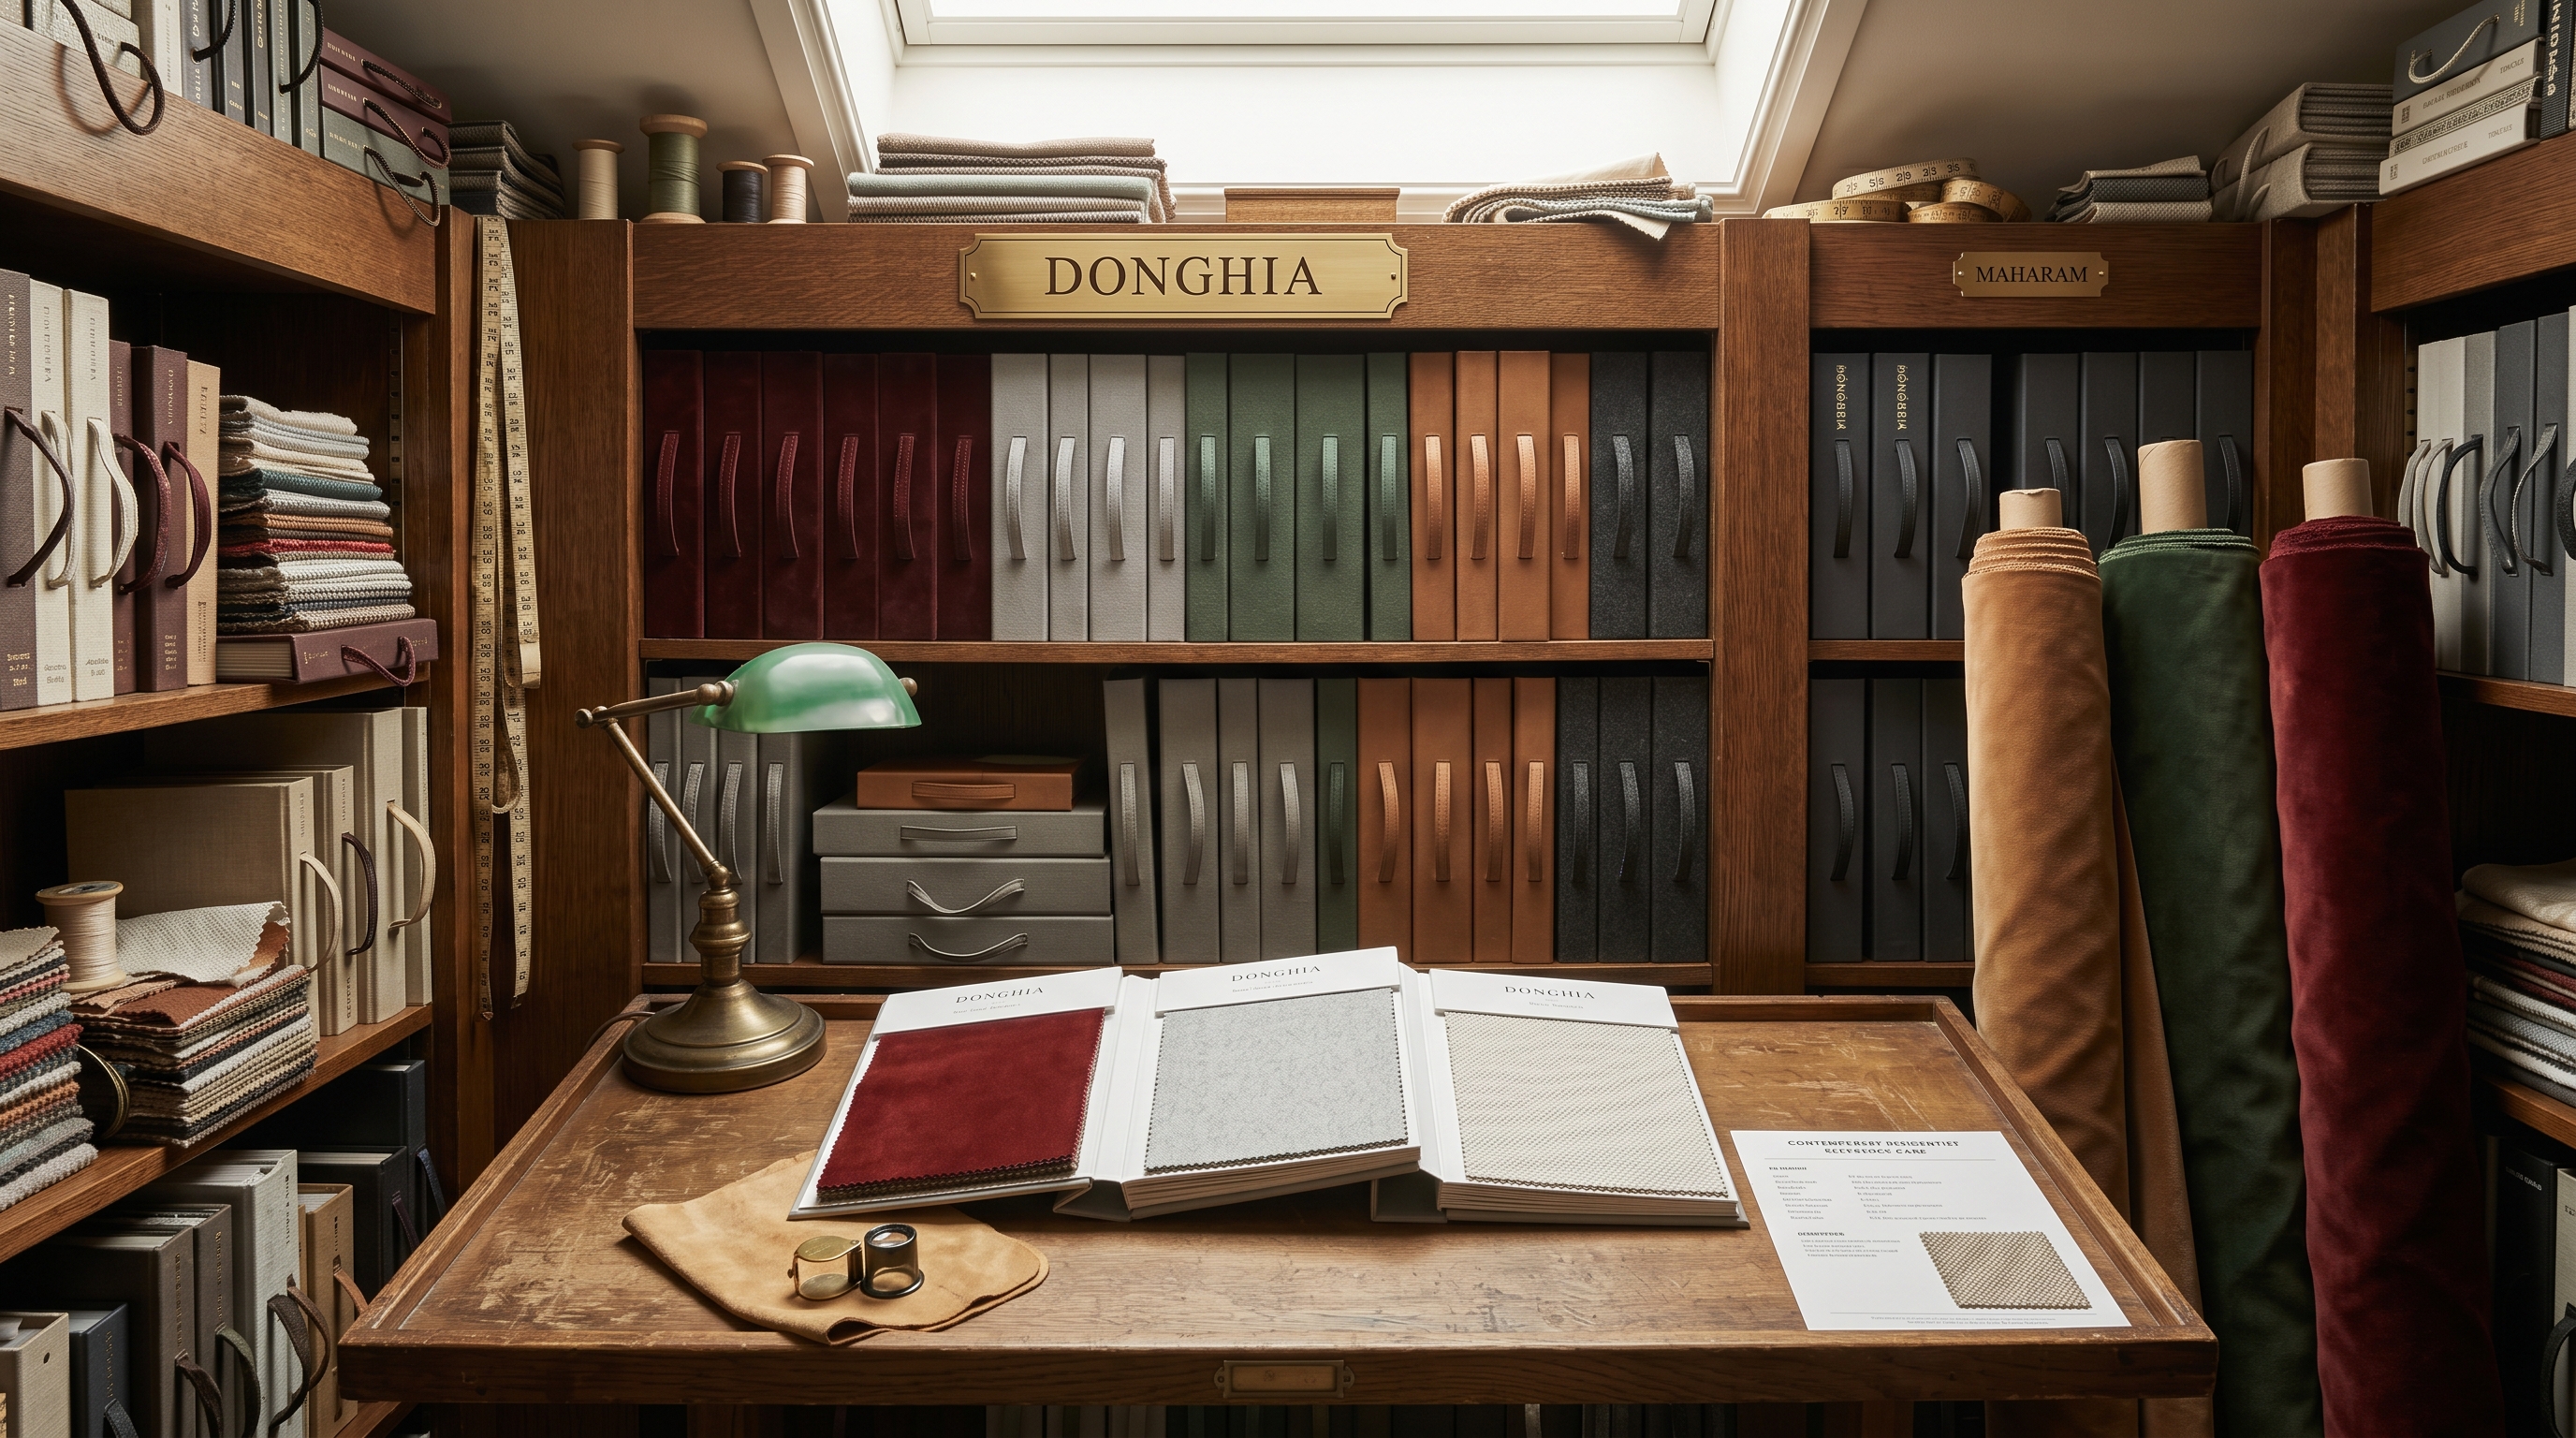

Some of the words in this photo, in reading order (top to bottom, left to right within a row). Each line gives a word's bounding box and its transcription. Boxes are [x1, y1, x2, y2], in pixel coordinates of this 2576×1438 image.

[1045, 256, 1323, 297] DONGHIA
[1975, 266, 2089, 284] MAHARAM
[1232, 965, 1321, 982] DONGHIA
[956, 987, 1044, 1004] DONGHIA
[1505, 986, 1595, 1000] DONGHIA
